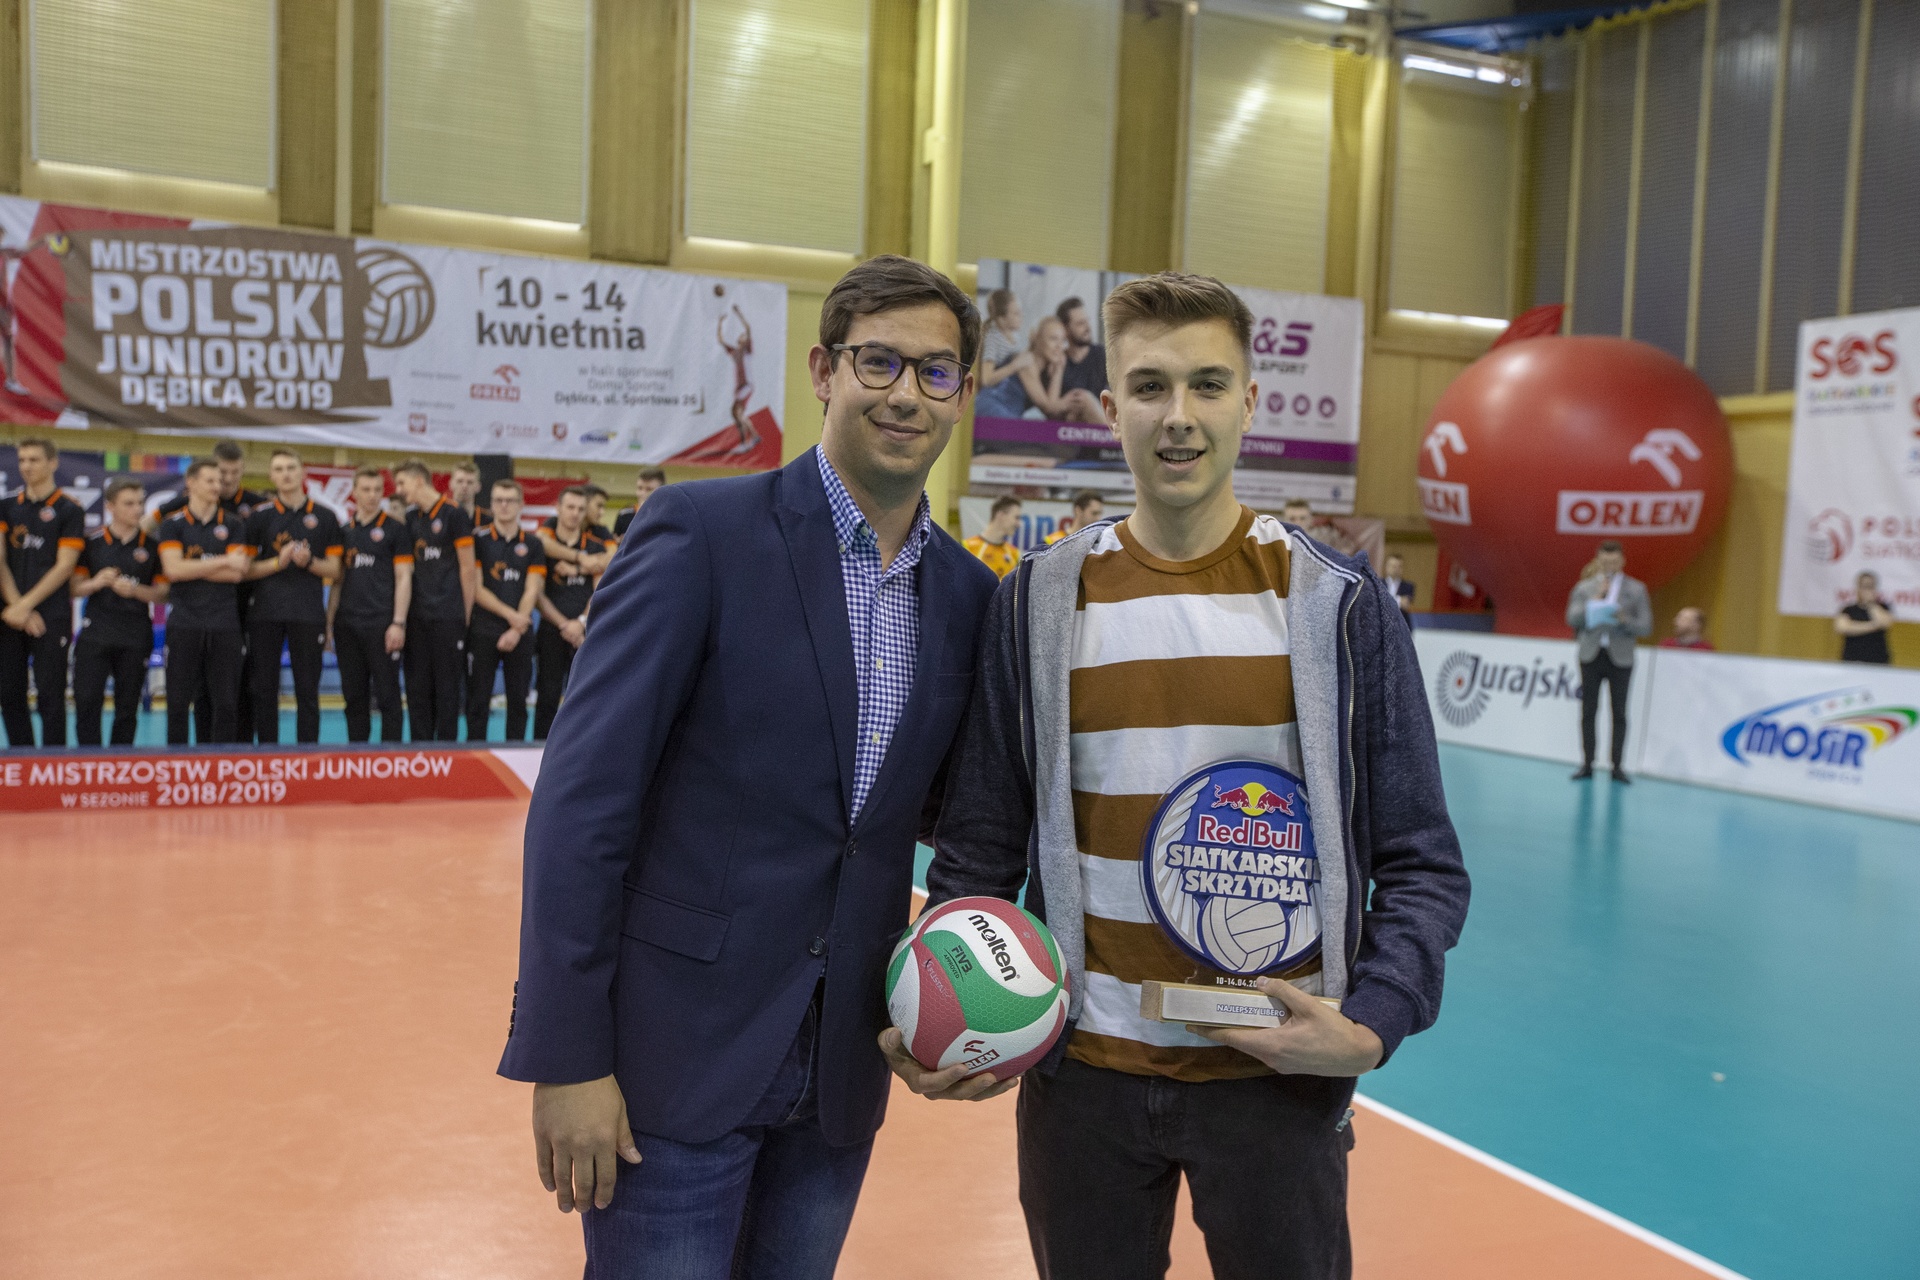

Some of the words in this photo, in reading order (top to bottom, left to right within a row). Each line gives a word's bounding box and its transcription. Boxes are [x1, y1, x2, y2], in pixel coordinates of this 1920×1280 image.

[90, 237, 343, 282] MISTRZOSTWA
[91, 272, 345, 341] POLSKI
[495, 277, 542, 308] 10
[581, 281, 626, 312] 14
[476, 311, 646, 350] kwietnia
[96, 333, 345, 382] JUNIORÓW
[120, 374, 247, 413] DĘBICA
[254, 379, 333, 411] 2019
[1569, 500, 1694, 527] ORLEN
[29, 760, 211, 787] MISTRZOSTW
[217, 758, 308, 782] POLSKI
[313, 751, 453, 780] JUNIORÓW
[61, 792, 77, 809] W
[80, 790, 150, 808] SEZONIE
[156, 780, 287, 806] 2018/2019
[1198, 814, 1251, 846] Red
[1251, 820, 1303, 851] Bull
[1184, 869, 1310, 903] SKRZYDŁA
[951, 945, 973, 973] FIVB
[967, 914, 1018, 982] molten
[943, 954, 960, 979] APPROVED
[1216, 976, 1258, 988] 10-14.04.20
[1216, 1003, 1258, 1015] NAJLEPSZY
[1260, 1009, 1286, 1017] LIBERO
[965, 1050, 998, 1070] RLEN
